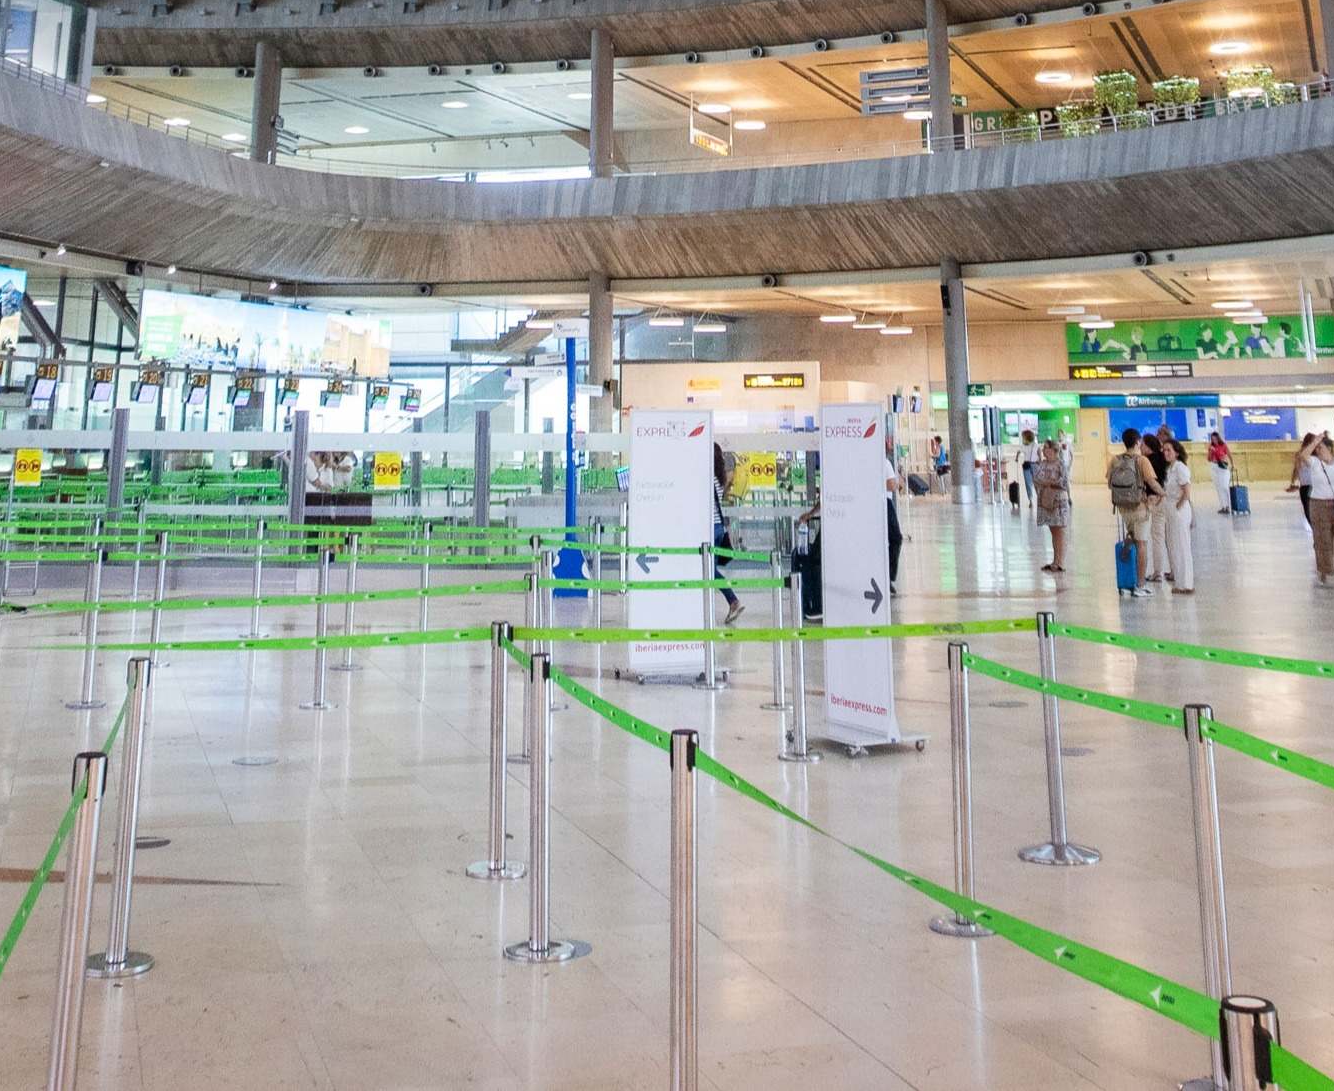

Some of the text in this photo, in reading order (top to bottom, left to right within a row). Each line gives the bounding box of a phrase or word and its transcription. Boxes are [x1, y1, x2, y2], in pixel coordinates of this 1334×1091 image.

[46, 364, 57, 378] 18
[102, 368, 112, 381] 19
[825, 426, 862, 438] EXPRESS
[831, 695, 888, 717] iberiaexpress.com
